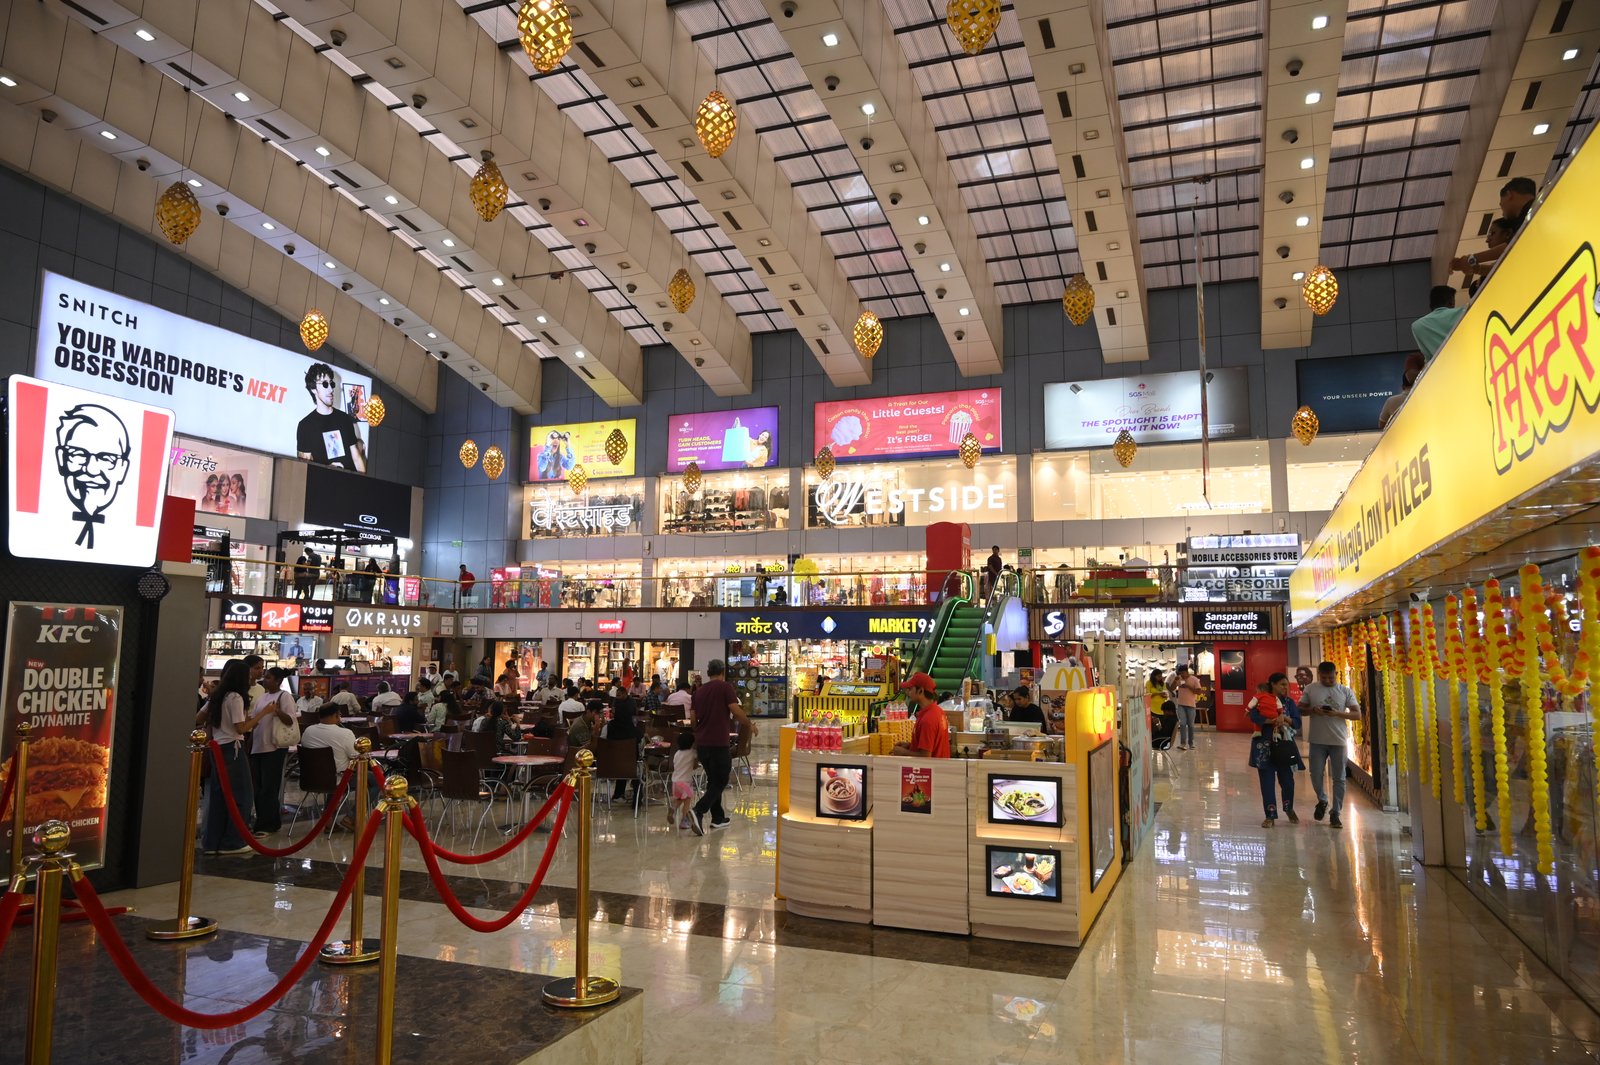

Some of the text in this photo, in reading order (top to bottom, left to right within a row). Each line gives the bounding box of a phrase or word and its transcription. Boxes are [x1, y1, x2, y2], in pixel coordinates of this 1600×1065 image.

[59, 293, 138, 330] SNITCH
[57, 323, 288, 404] YOUR WARDROBE'S NEXT
[54, 347, 175, 395] OBSESSION
[872, 405, 945, 419] Little Guests!
[1101, 416, 1157, 427] SPOTLIGHT
[1139, 424, 1148, 432] IT
[1150, 422, 1180, 431] NOW!
[887, 434, 932, 444] It's FREE!
[582, 455, 594, 464] BE
[815, 471, 1006, 524] WESTSIDE
[1336, 442, 1433, 575] Always Low Prices
[1192, 551, 1298, 562] MOBILE ACCESSORIES STORE
[1216, 567, 1275, 578] MOBILE
[225, 614, 257, 622] OAKLEY
[365, 611, 421, 627] KRAUS
[1205, 612, 1258, 622] Sanspareils
[735, 616, 773, 634] मार्केट
[1204, 621, 1258, 630] Greenlands
[36, 625, 94, 644] KFC
[28, 660, 45, 668] NEW
[23, 666, 104, 691] DOUBLE
[16, 689, 107, 714] CHICKEN
[31, 712, 91, 728] DYNAMITE
[71, 817, 100, 828] CHICKEN
